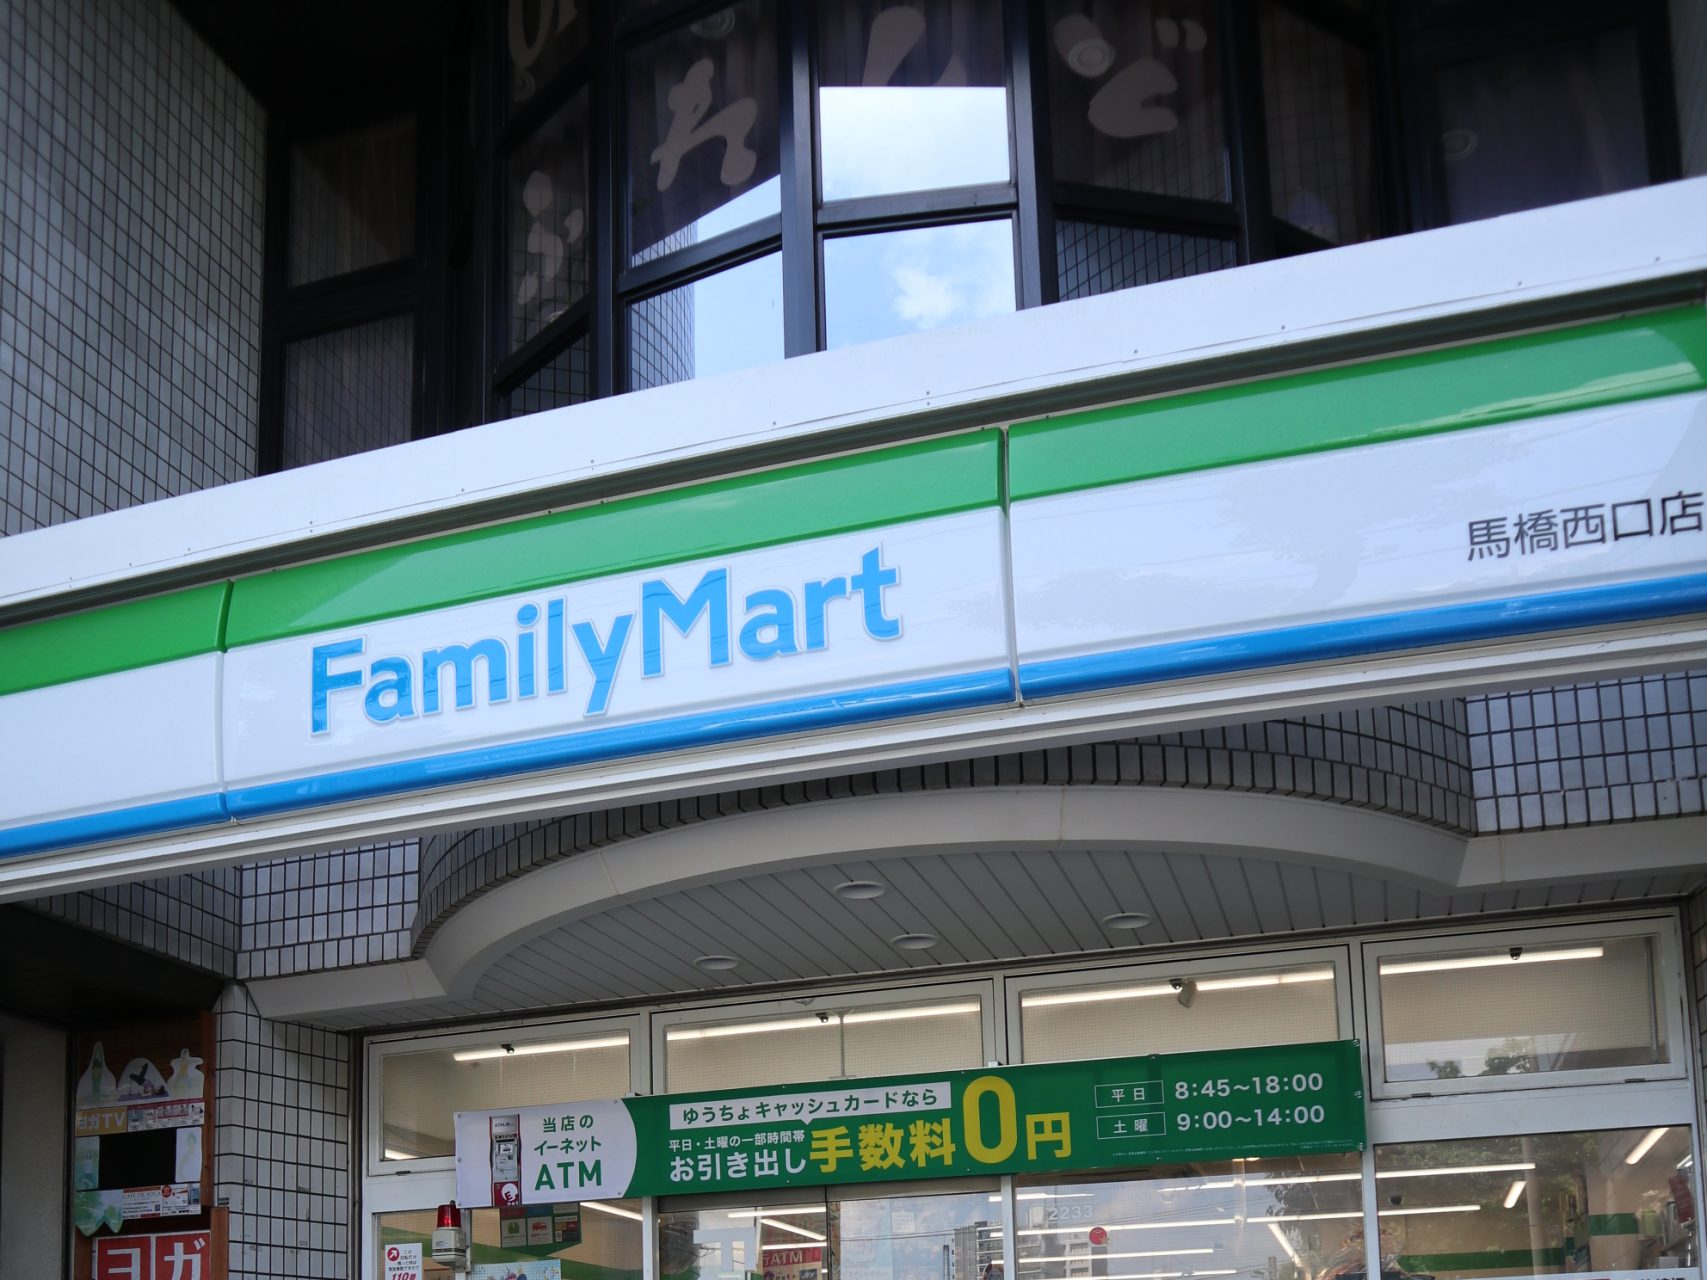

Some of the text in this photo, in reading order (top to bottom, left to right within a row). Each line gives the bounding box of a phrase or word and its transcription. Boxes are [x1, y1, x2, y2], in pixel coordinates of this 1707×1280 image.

[1467, 490, 1704, 561] 馬橋西口店
[309, 543, 903, 737] FamilyMart
[683, 1088, 938, 1126] ゆうちょキャッシュカードなら
[1111, 1087, 1146, 1103] 平日
[542, 1114, 594, 1134] 当店の
[1113, 1118, 1149, 1134] 土曜
[534, 1136, 602, 1156] イーネット
[669, 1129, 805, 1153] 平日・土曜の一部時間帯
[534, 1160, 602, 1191] ATM
[669, 1148, 807, 1183] お引き出し
[1048, 1205, 1094, 1220] 2233
